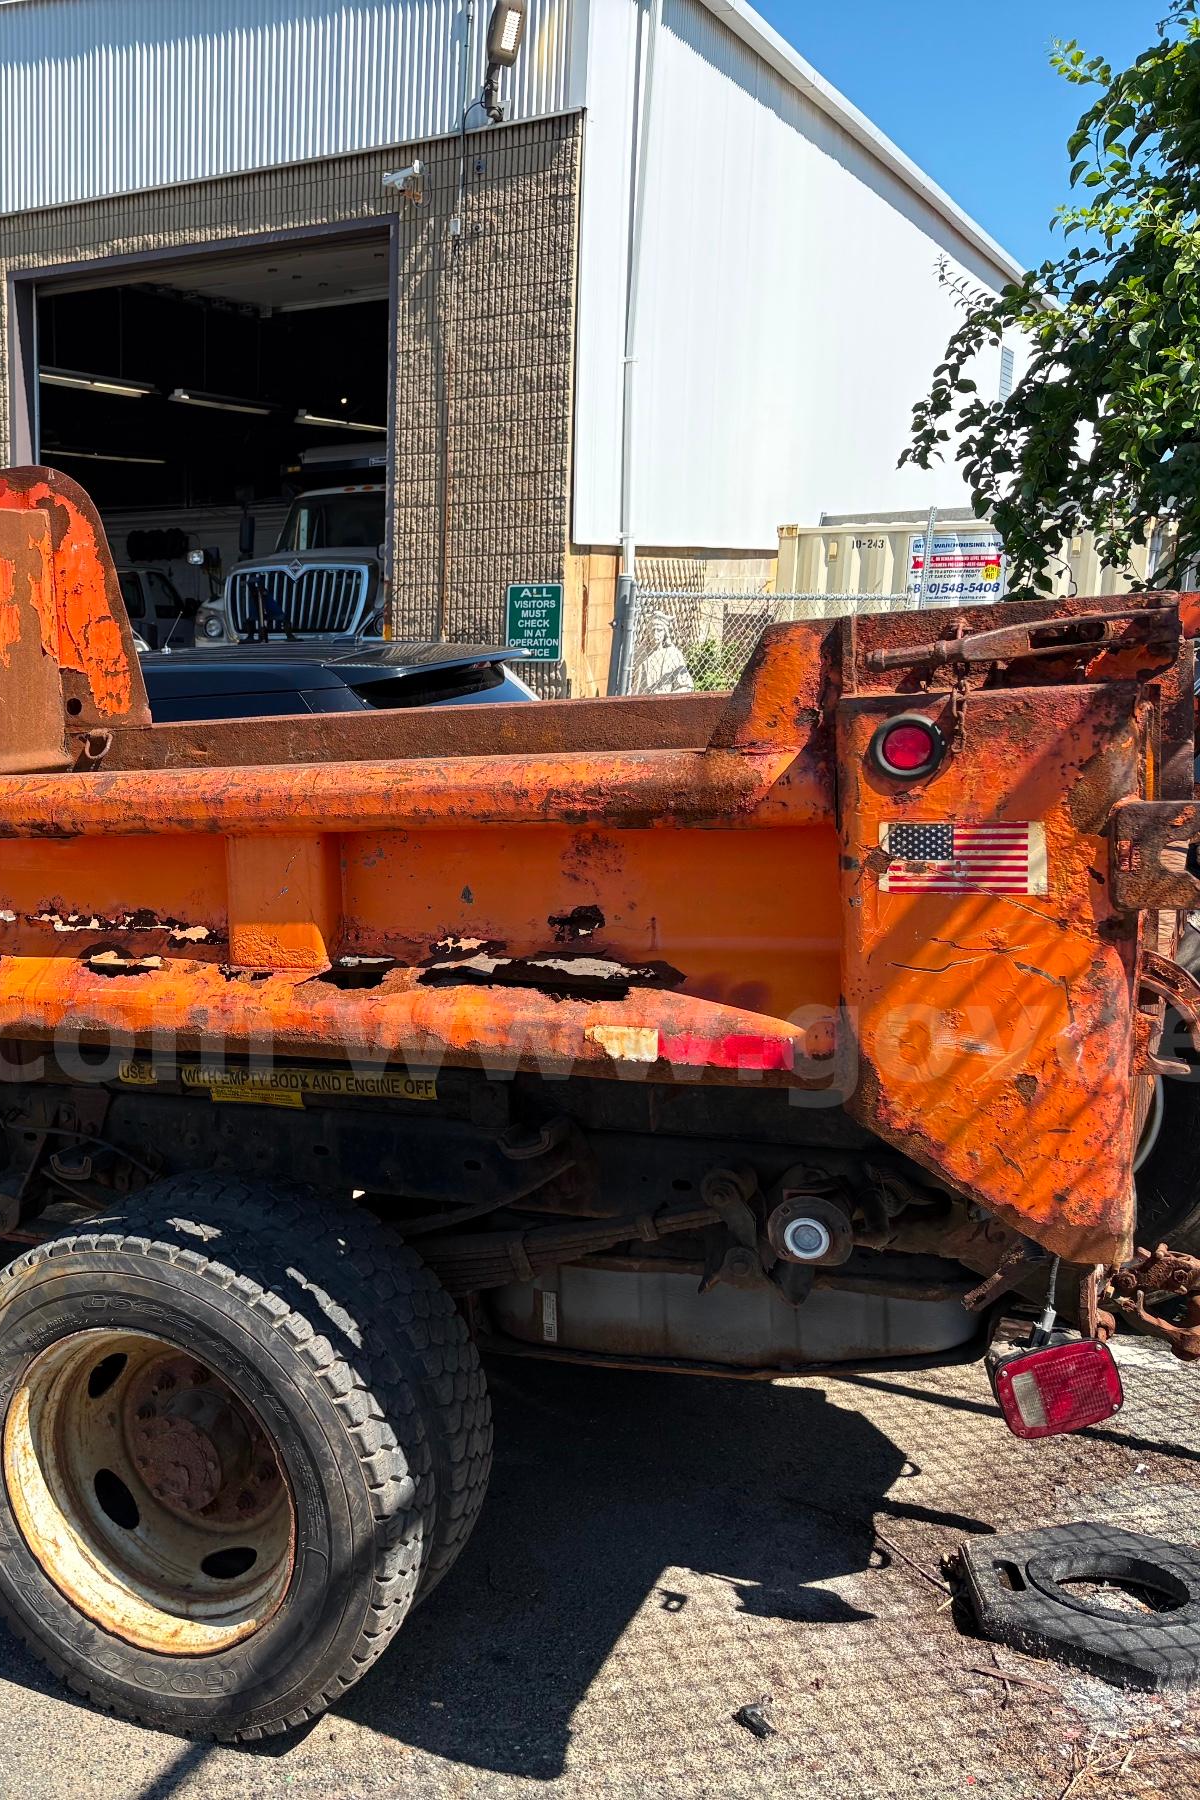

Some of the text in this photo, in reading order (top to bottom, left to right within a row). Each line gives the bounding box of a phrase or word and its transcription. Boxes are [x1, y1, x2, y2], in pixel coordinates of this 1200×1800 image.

[520, 588, 552, 597] ALL
[514, 600, 556, 608] VISITORS
[521, 610, 547, 618] MUST
[518, 620, 550, 628] CHECK
[509, 638, 559, 647] OPERATION
[122, 1065, 147, 1080] USE
[184, 1068, 218, 1085] WITH
[221, 1070, 267, 1087] EMPTY
[312, 1075, 342, 1091] AND
[345, 1078, 400, 1095] ENGINE
[404, 1079, 433, 1096] OFF
